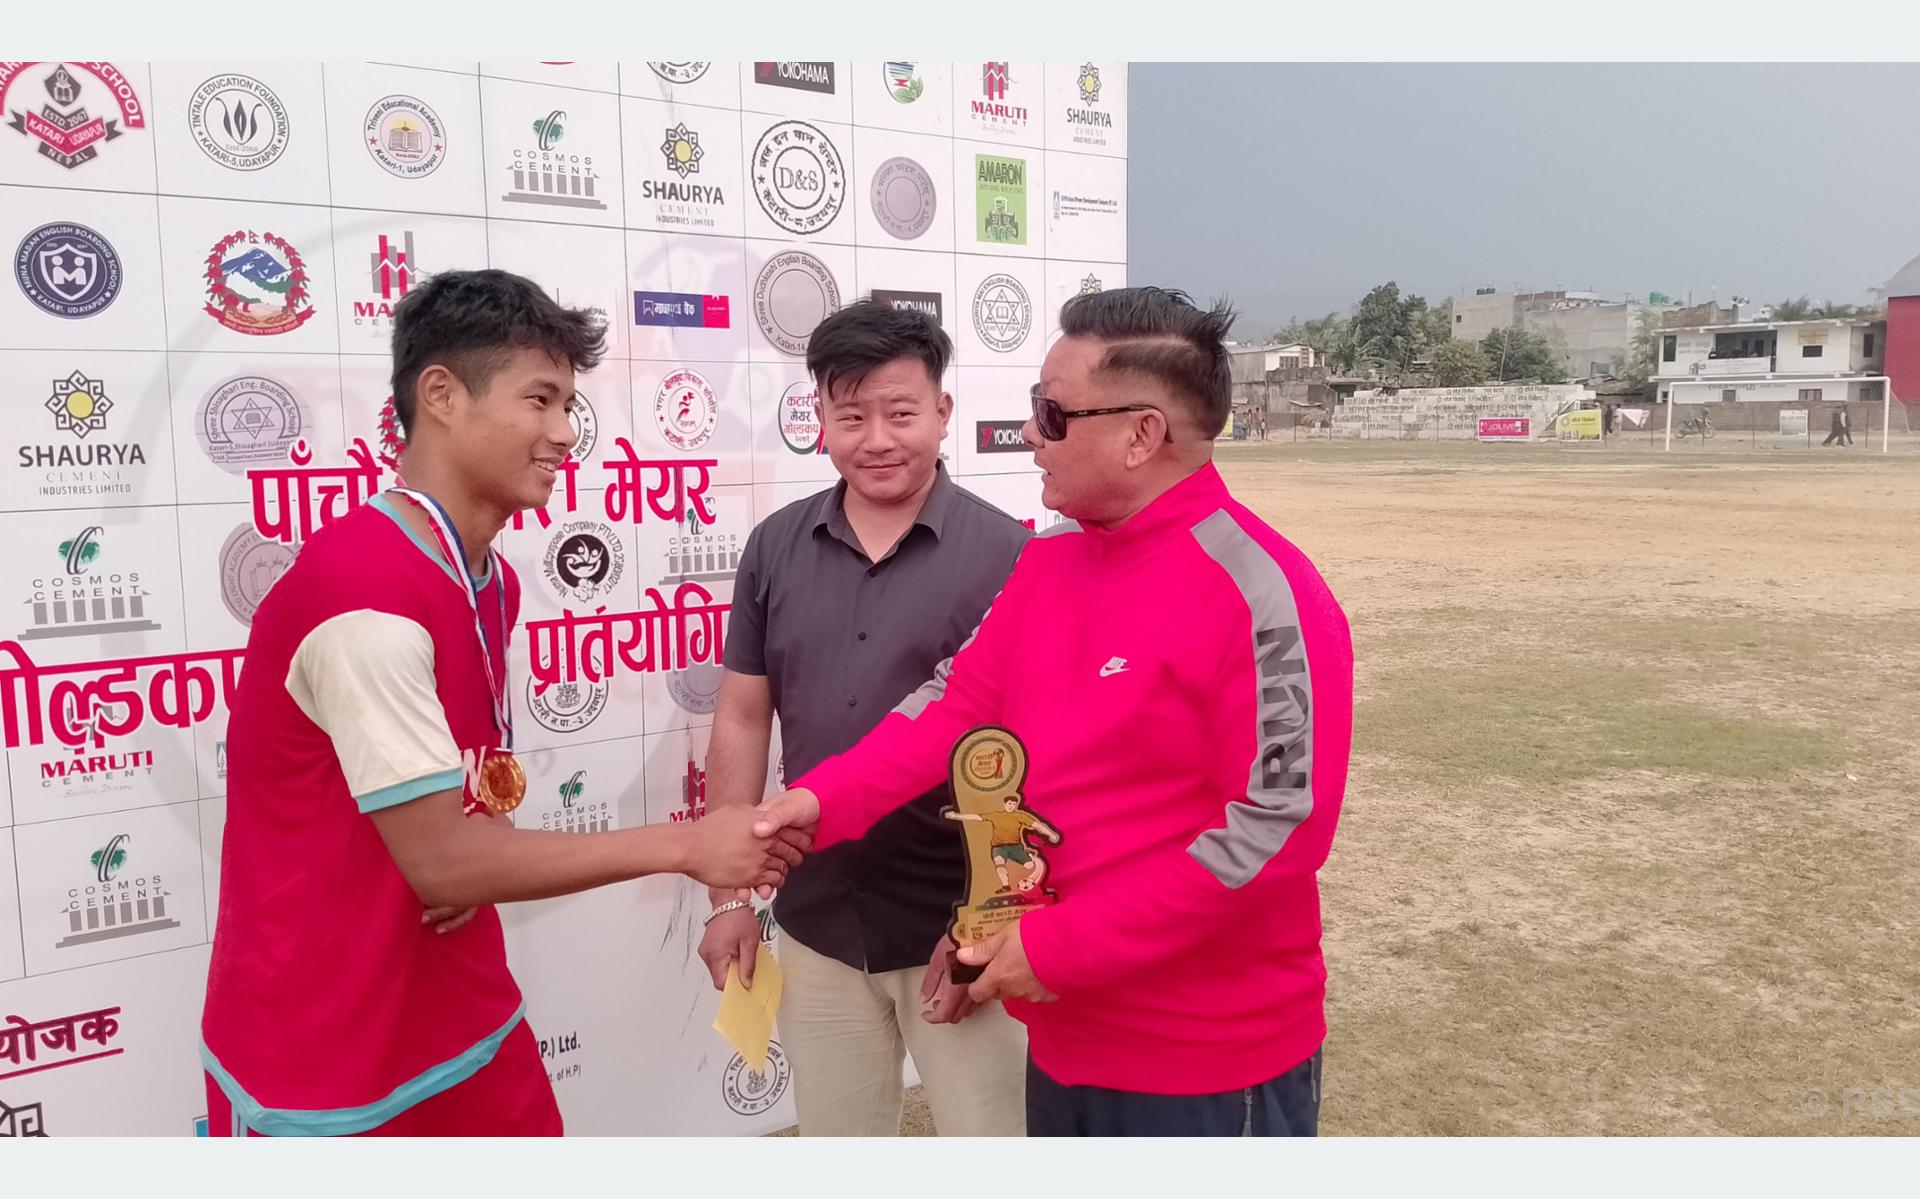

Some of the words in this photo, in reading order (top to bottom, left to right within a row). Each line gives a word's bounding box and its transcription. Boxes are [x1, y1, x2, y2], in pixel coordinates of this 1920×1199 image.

[777, 62, 830, 84] YOKOHAMA
[91, 62, 140, 124] SCHOOL
[192, 92, 207, 128] TINTALE
[202, 77, 253, 96] EDUCATION
[253, 84, 287, 138] FOUNDATION
[972, 100, 1027, 120] MARUTI
[1066, 107, 1112, 128] SHAURYA
[381, 99, 419, 112] Educational
[419, 107, 441, 138] Academy
[971, 113, 1027, 127] CEMENT
[28, 118, 65, 145] KATARI
[48, 148, 89, 166] NEPAL
[407, 153, 438, 173] Udayapur
[513, 149, 592, 165] COSMOS
[513, 160, 592, 176] CEMENT
[778, 166, 819, 191] D&S
[978, 160, 1022, 185] AMARON
[642, 180, 725, 205] SHAURYA
[39, 226, 73, 240] ENGLISH
[75, 227, 112, 259] BOARDING
[20, 235, 40, 263] MADAN
[20, 264, 33, 289] MUNA
[107, 259, 118, 291] SCHOOL
[758, 301, 769, 326] Shree
[776, 254, 800, 267] English
[801, 256, 827, 283] Boarding
[825, 280, 837, 308] School
[67, 296, 105, 314] UDAYAPUR
[209, 417, 221, 440] Shree
[240, 380, 258, 391] Eng.
[259, 381, 291, 408] Boarding
[286, 406, 298, 435] School
[790, 408, 812, 422] मेयर
[994, 428, 1025, 445] YOKOHA
[18, 443, 147, 468] SHAURYA
[45, 470, 123, 483] CEMENT
[603, 437, 718, 525] मेयर
[39, 485, 93, 496] INDUSTRIES
[96, 484, 131, 494] LIMITED
[562, 520, 598, 534] Company
[668, 534, 737, 545] COSMOS
[669, 543, 737, 555] CEMENT
[32, 572, 140, 588] COSMOS
[33, 585, 140, 602] CEMENT
[1255, 626, 1309, 789] RUN
[40, 750, 153, 779] MARUTI
[41, 767, 153, 788] CEMENT
[542, 802, 608, 820] COSMOS
[543, 811, 607, 830] CEMENT
[669, 807, 705, 823] MAR
[68, 875, 162, 898] COSMOS
[69, 886, 162, 910] CEMENT
[0, 1005, 122, 1065] योजक
[559, 1030, 581, 1054] Ltd.
[556, 1067, 564, 1081] of
